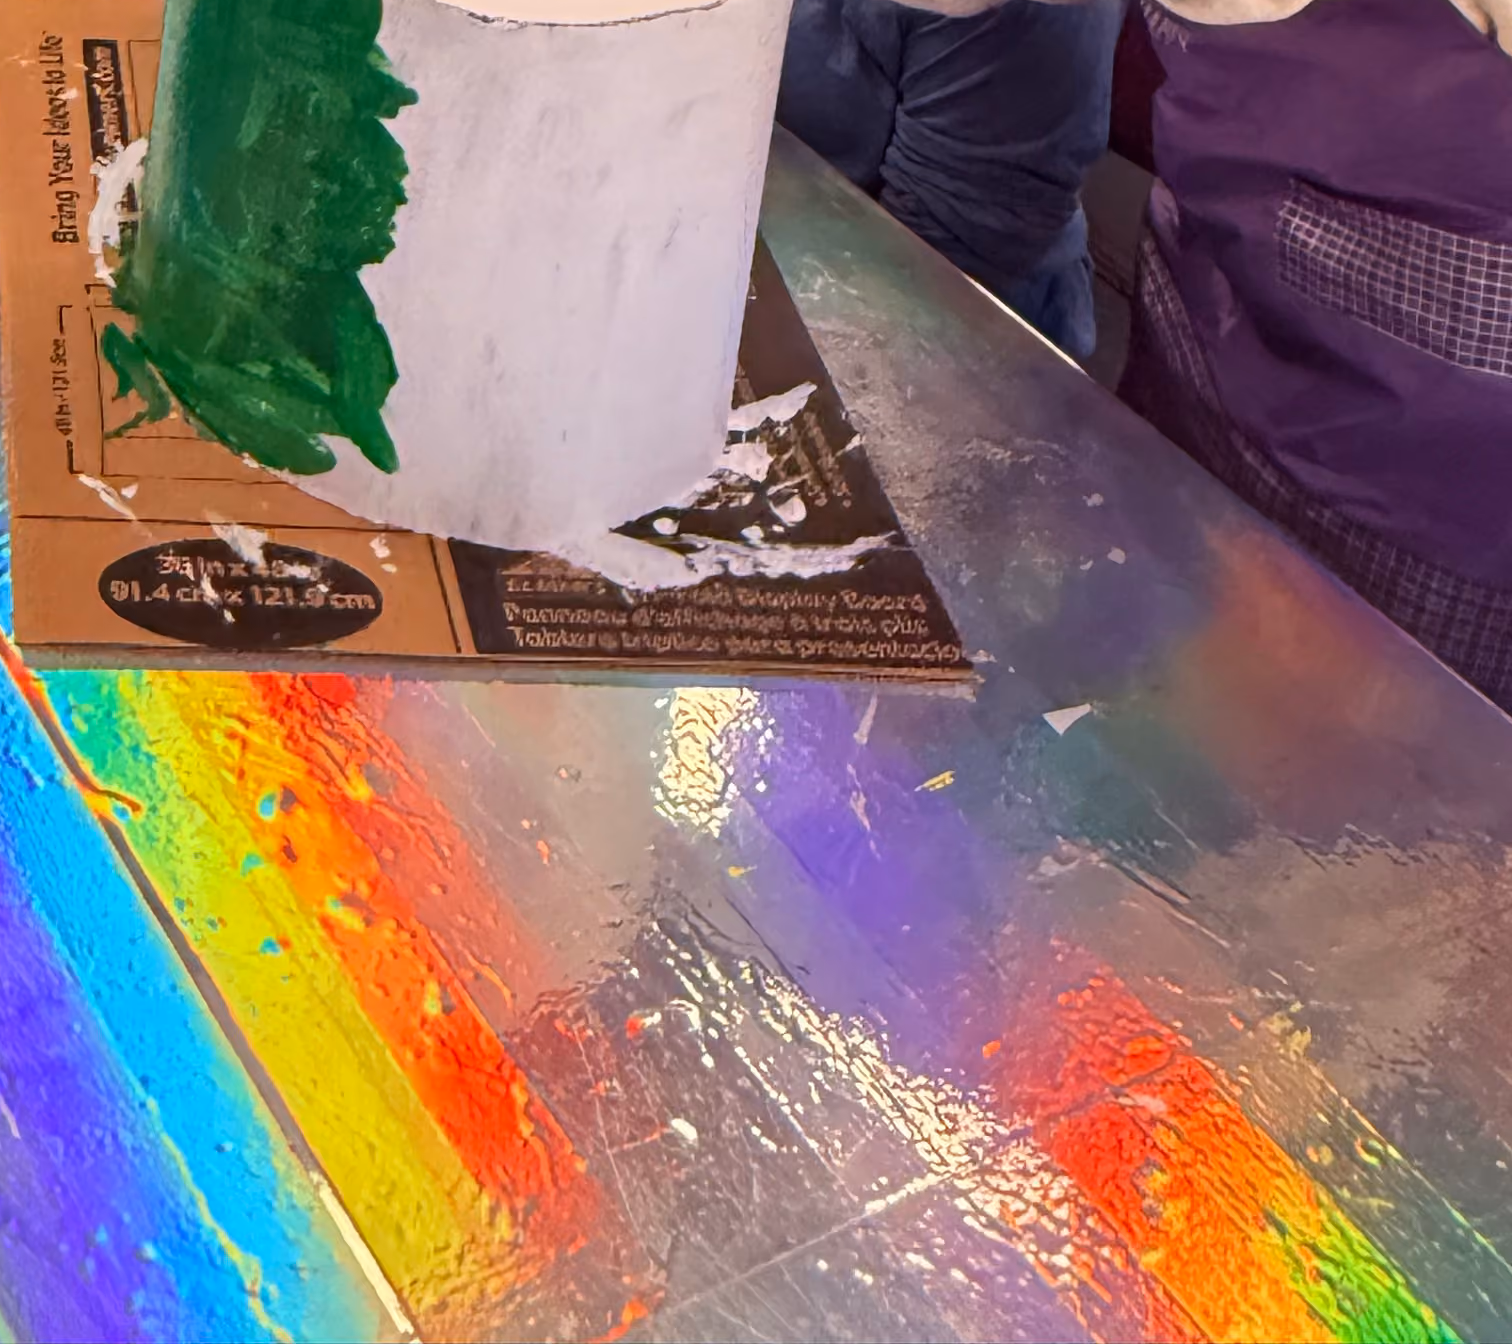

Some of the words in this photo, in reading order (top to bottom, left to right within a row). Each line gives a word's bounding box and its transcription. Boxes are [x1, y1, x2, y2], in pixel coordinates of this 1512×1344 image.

[46, 138, 74, 187] Your
[50, 190, 80, 244] Bring
[110, 579, 171, 603] 91.4
[250, 585, 325, 609] 121.9
